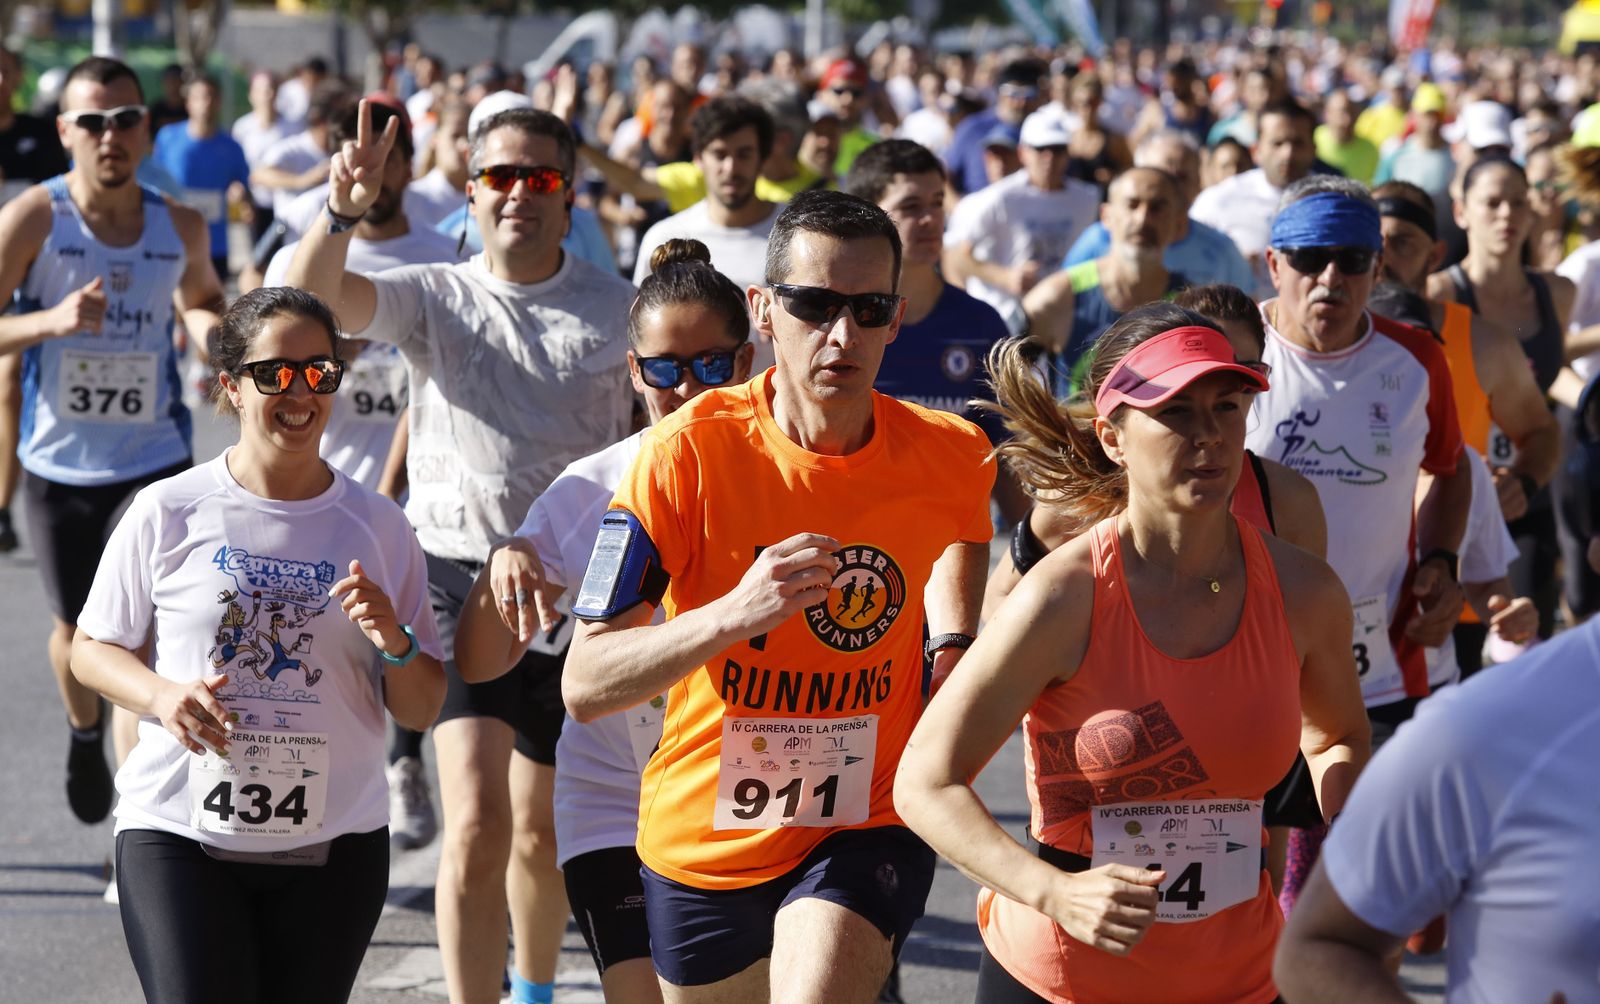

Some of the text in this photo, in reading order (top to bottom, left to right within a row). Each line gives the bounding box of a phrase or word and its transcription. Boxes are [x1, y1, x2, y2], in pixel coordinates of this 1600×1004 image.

[69, 386, 143, 415] 376
[228, 552, 317, 580] Carrera
[318, 561, 333, 573] de
[243, 570, 322, 596] Prensa
[810, 605, 898, 649] RUNNERS
[721, 658, 892, 714] RUNNING
[258, 734, 272, 744] DE
[274, 735, 287, 745] LA
[288, 735, 322, 746] PRENSA
[731, 720, 868, 734] IV CARRERA DE LA PRENSA
[1041, 706, 1176, 771] MADE
[244, 745, 270, 758] APM
[783, 736, 812, 750] APM
[203, 780, 309, 825] 434
[731, 774, 840, 820] 911
[1114, 805, 1172, 818] CARRERA
[1174, 805, 1190, 816] DE
[1192, 804, 1206, 815] LA
[1208, 803, 1251, 814] PRENSA
[1160, 818, 1188, 832] APM
[1145, 862, 1206, 911] 4
